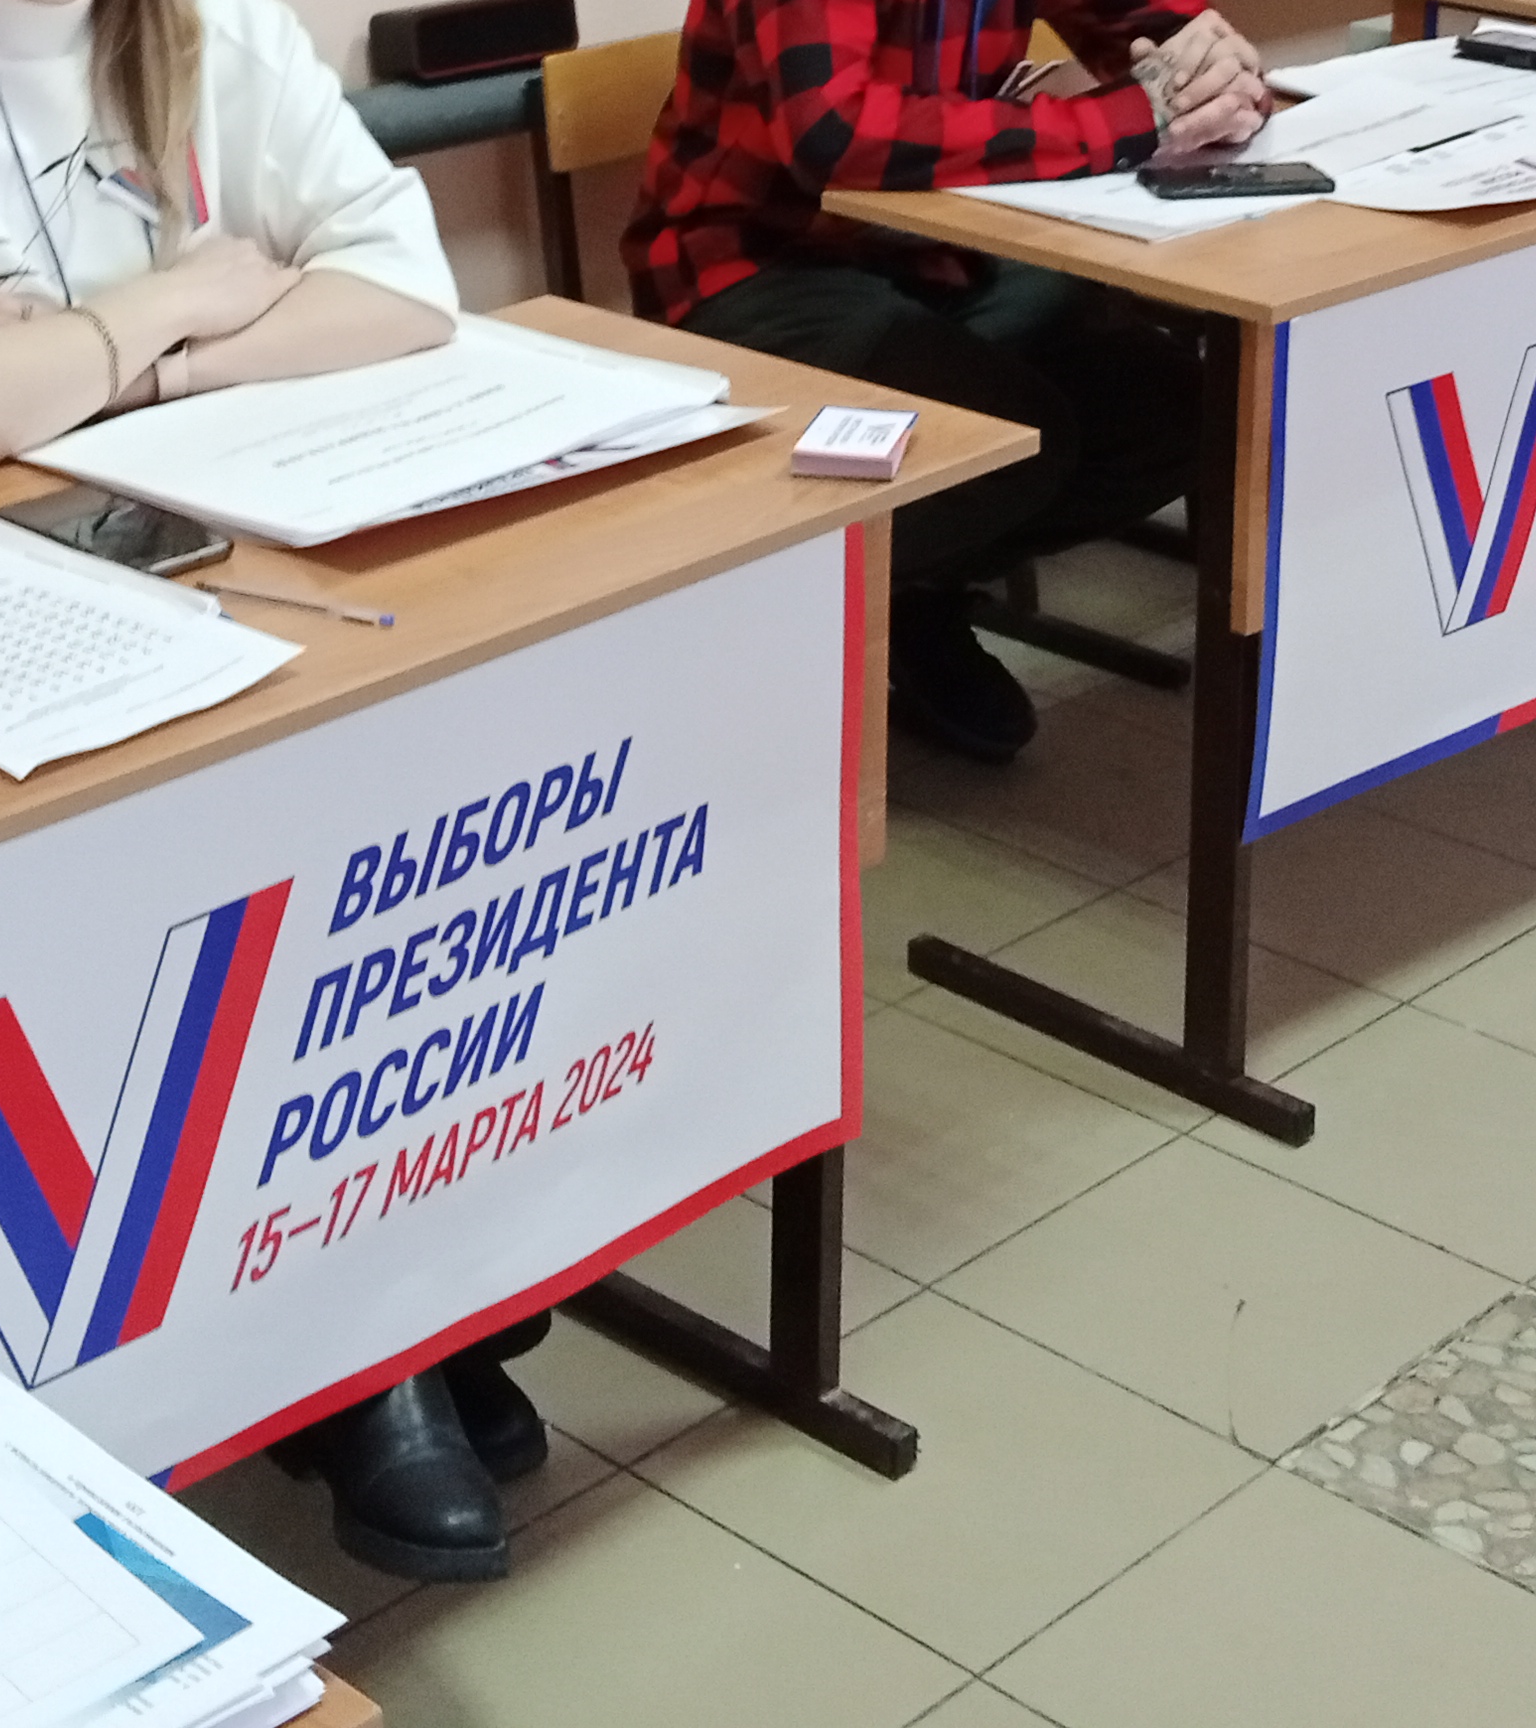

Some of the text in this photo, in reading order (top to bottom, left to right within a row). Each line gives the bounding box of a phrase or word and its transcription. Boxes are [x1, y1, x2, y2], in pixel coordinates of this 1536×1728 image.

[292, 802, 710, 1063] ПРЕЗИДЕНТА
[328, 735, 633, 937] ВЫБОРЫ
[257, 981, 546, 1190] РОССИИ
[380, 1080, 545, 1220] МАРТА
[550, 1020, 656, 1132] 2024
